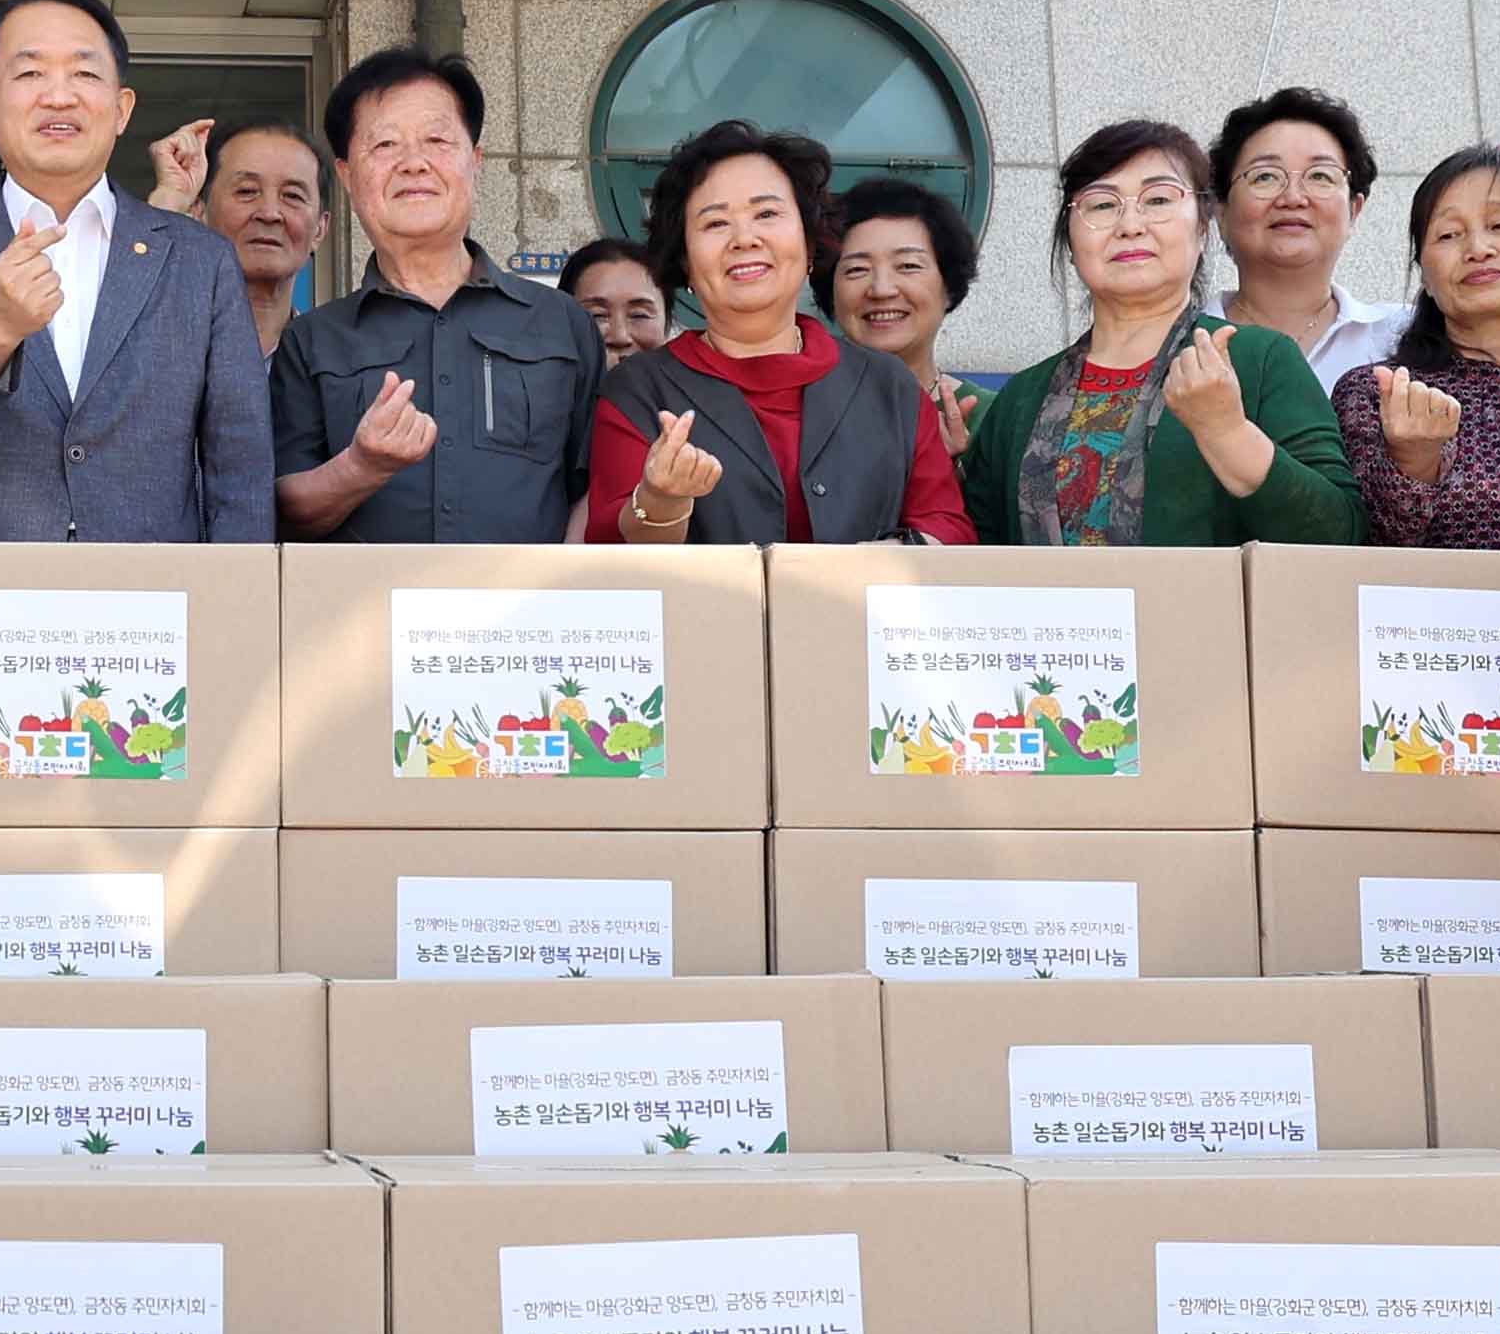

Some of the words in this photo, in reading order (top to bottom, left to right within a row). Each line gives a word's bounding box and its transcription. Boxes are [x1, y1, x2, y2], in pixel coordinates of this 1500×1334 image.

[1376, 651, 1409, 670] 농촌
[1412, 652, 1491, 672] 일손돕기와
[54, 1105, 91, 1127] 행복
[95, 1106, 152, 1127] 꾸러미
[156, 1106, 194, 1127] 나눔
[493, 1104, 532, 1127] 농촌
[536, 1100, 630, 1126] 일손돕기와
[633, 1100, 672, 1123] 행복
[675, 1098, 732, 1121] 꾸러미
[735, 1097, 774, 1120] 나눔
[1031, 1122, 1070, 1144] 농촌
[1073, 1120, 1165, 1143] 일손돕기와
[1169, 1121, 1206, 1143] 행복
[1209, 1120, 1265, 1142] 꾸러미
[1268, 1120, 1305, 1142] 나눔
[83, 1297, 127, 1316] 금창동
[132, 1297, 206, 1315] 주민자치회
[523, 1299, 583, 1322] 함께하는
[724, 1291, 768, 1312] 금창동
[771, 1288, 845, 1309] 주민자치회
[1179, 1298, 1237, 1317] 함께하는
[1375, 1299, 1417, 1317] 금창동
[1421, 1300, 1493, 1317] 주민자치회
